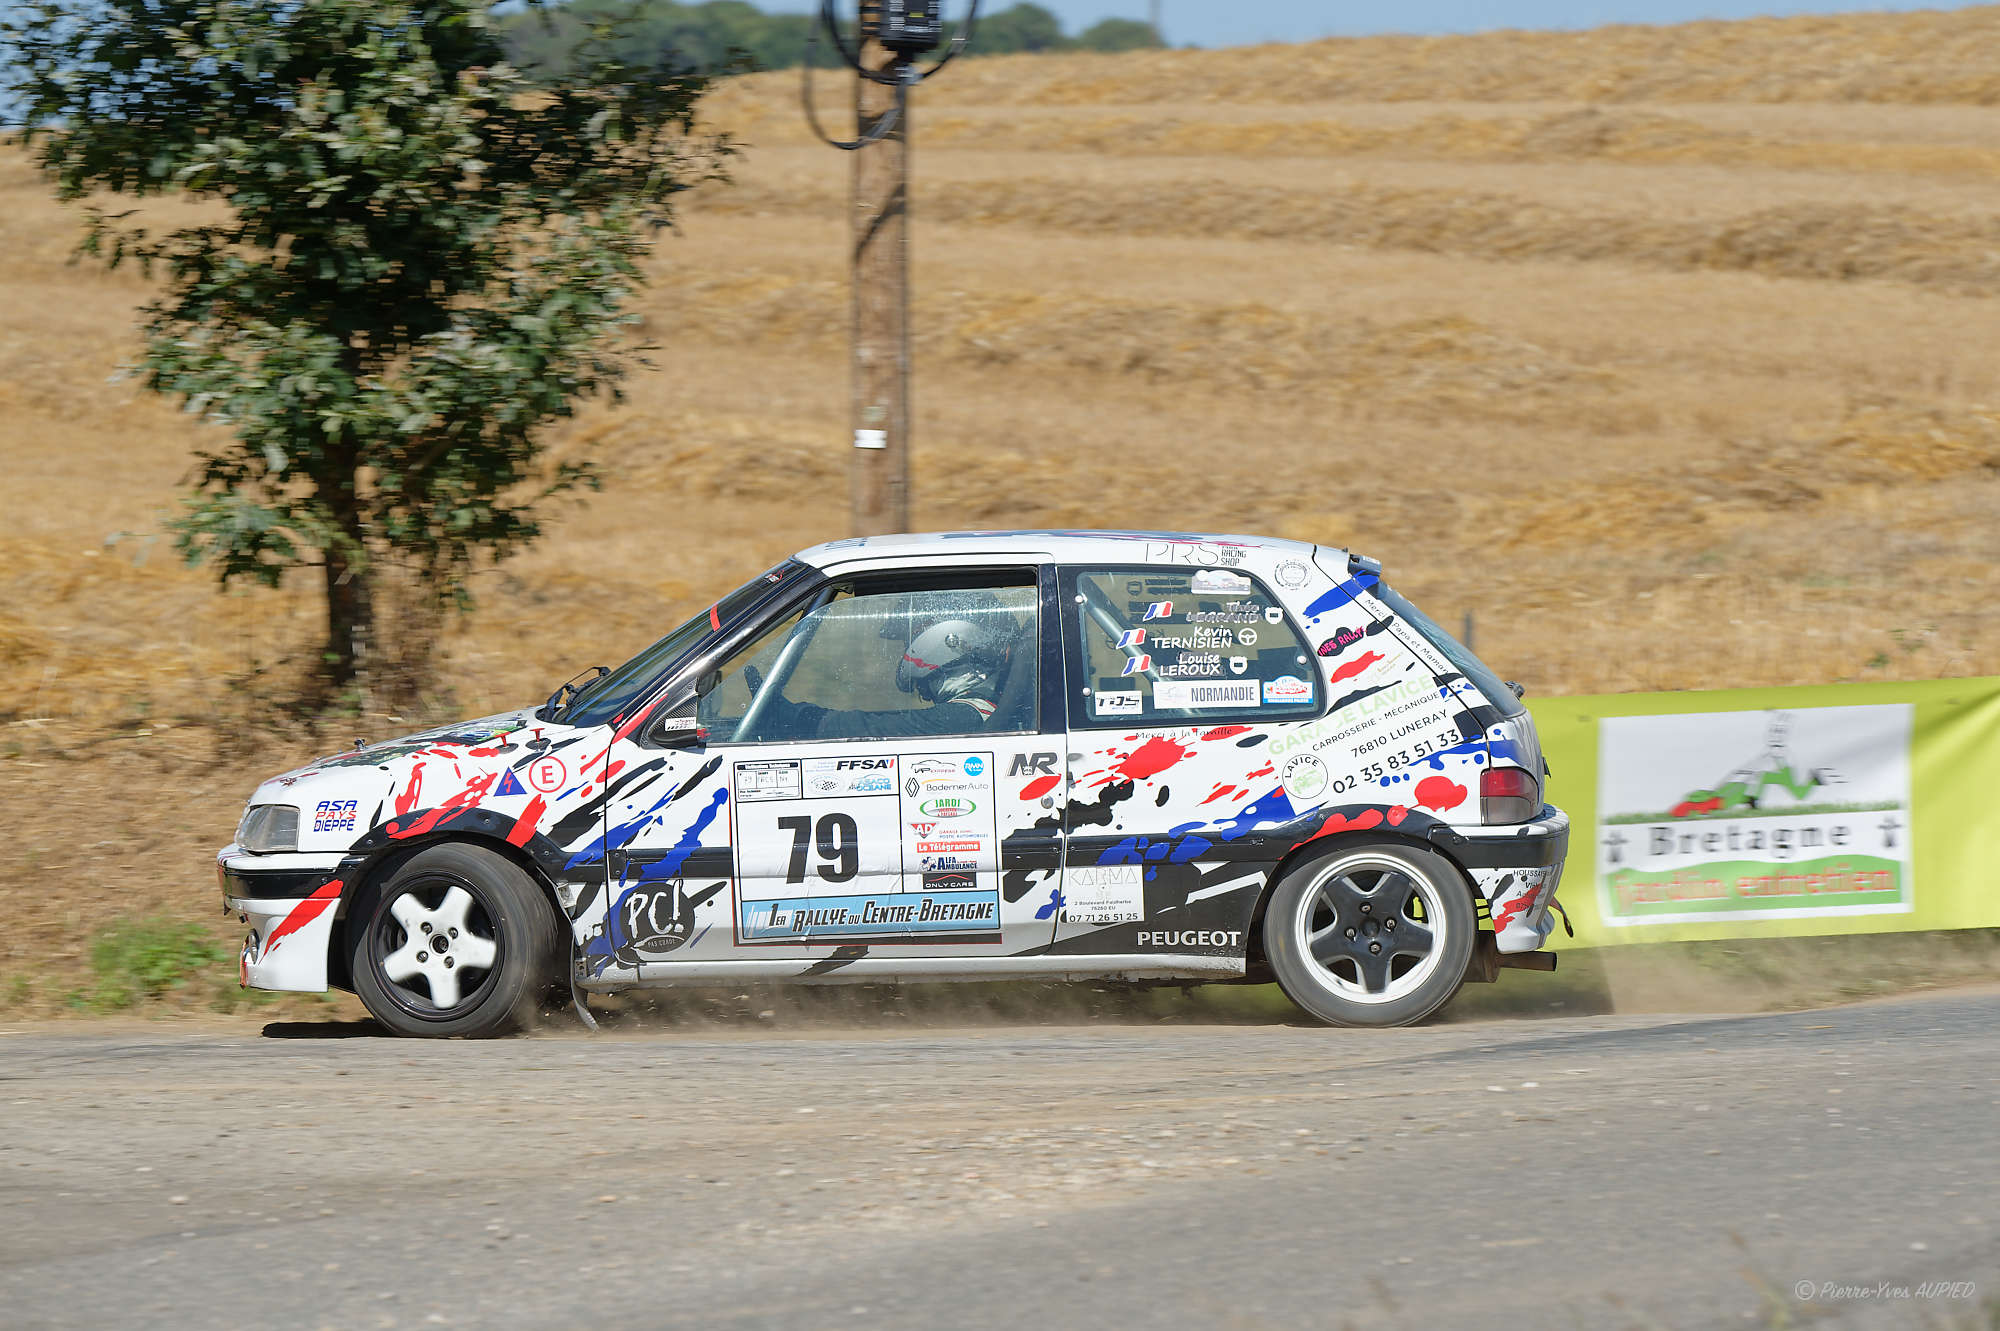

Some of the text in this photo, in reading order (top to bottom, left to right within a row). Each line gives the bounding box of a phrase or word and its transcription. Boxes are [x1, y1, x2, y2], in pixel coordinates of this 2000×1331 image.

[1145, 543, 1219, 566] PRS
[1220, 557, 1241, 567] SHOP
[1193, 625, 1233, 637] Kevin
[1151, 637, 1233, 649] TERNISIEN
[1179, 651, 1221, 664] Louise
[1160, 664, 1221, 677] LEROUX
[1190, 686, 1255, 703] NORMANDIE
[1361, 674, 1434, 716] LAVICE
[1312, 718, 1377, 752] CARROSSERIE
[1350, 709, 1448, 759] 76810 LUNERAY
[836, 759, 888, 771] FFSA
[1284, 756, 1320, 779] LAVICE
[1332, 728, 1460, 794] 02 35 83 51 33
[541, 765, 555, 784] E
[315, 799, 358, 812] ASA
[314, 810, 357, 820] PAYS
[313, 818, 355, 832] DIEPPE
[916, 822, 933, 834] AD
[777, 812, 859, 885] 79
[918, 843, 928, 852] Le
[1647, 824, 1852, 860] Bretagne
[792, 907, 848, 933] RALLYE
[1069, 912, 1138, 923] 07 71 26 51 25
[1137, 930, 1242, 947] PEUGEOT
